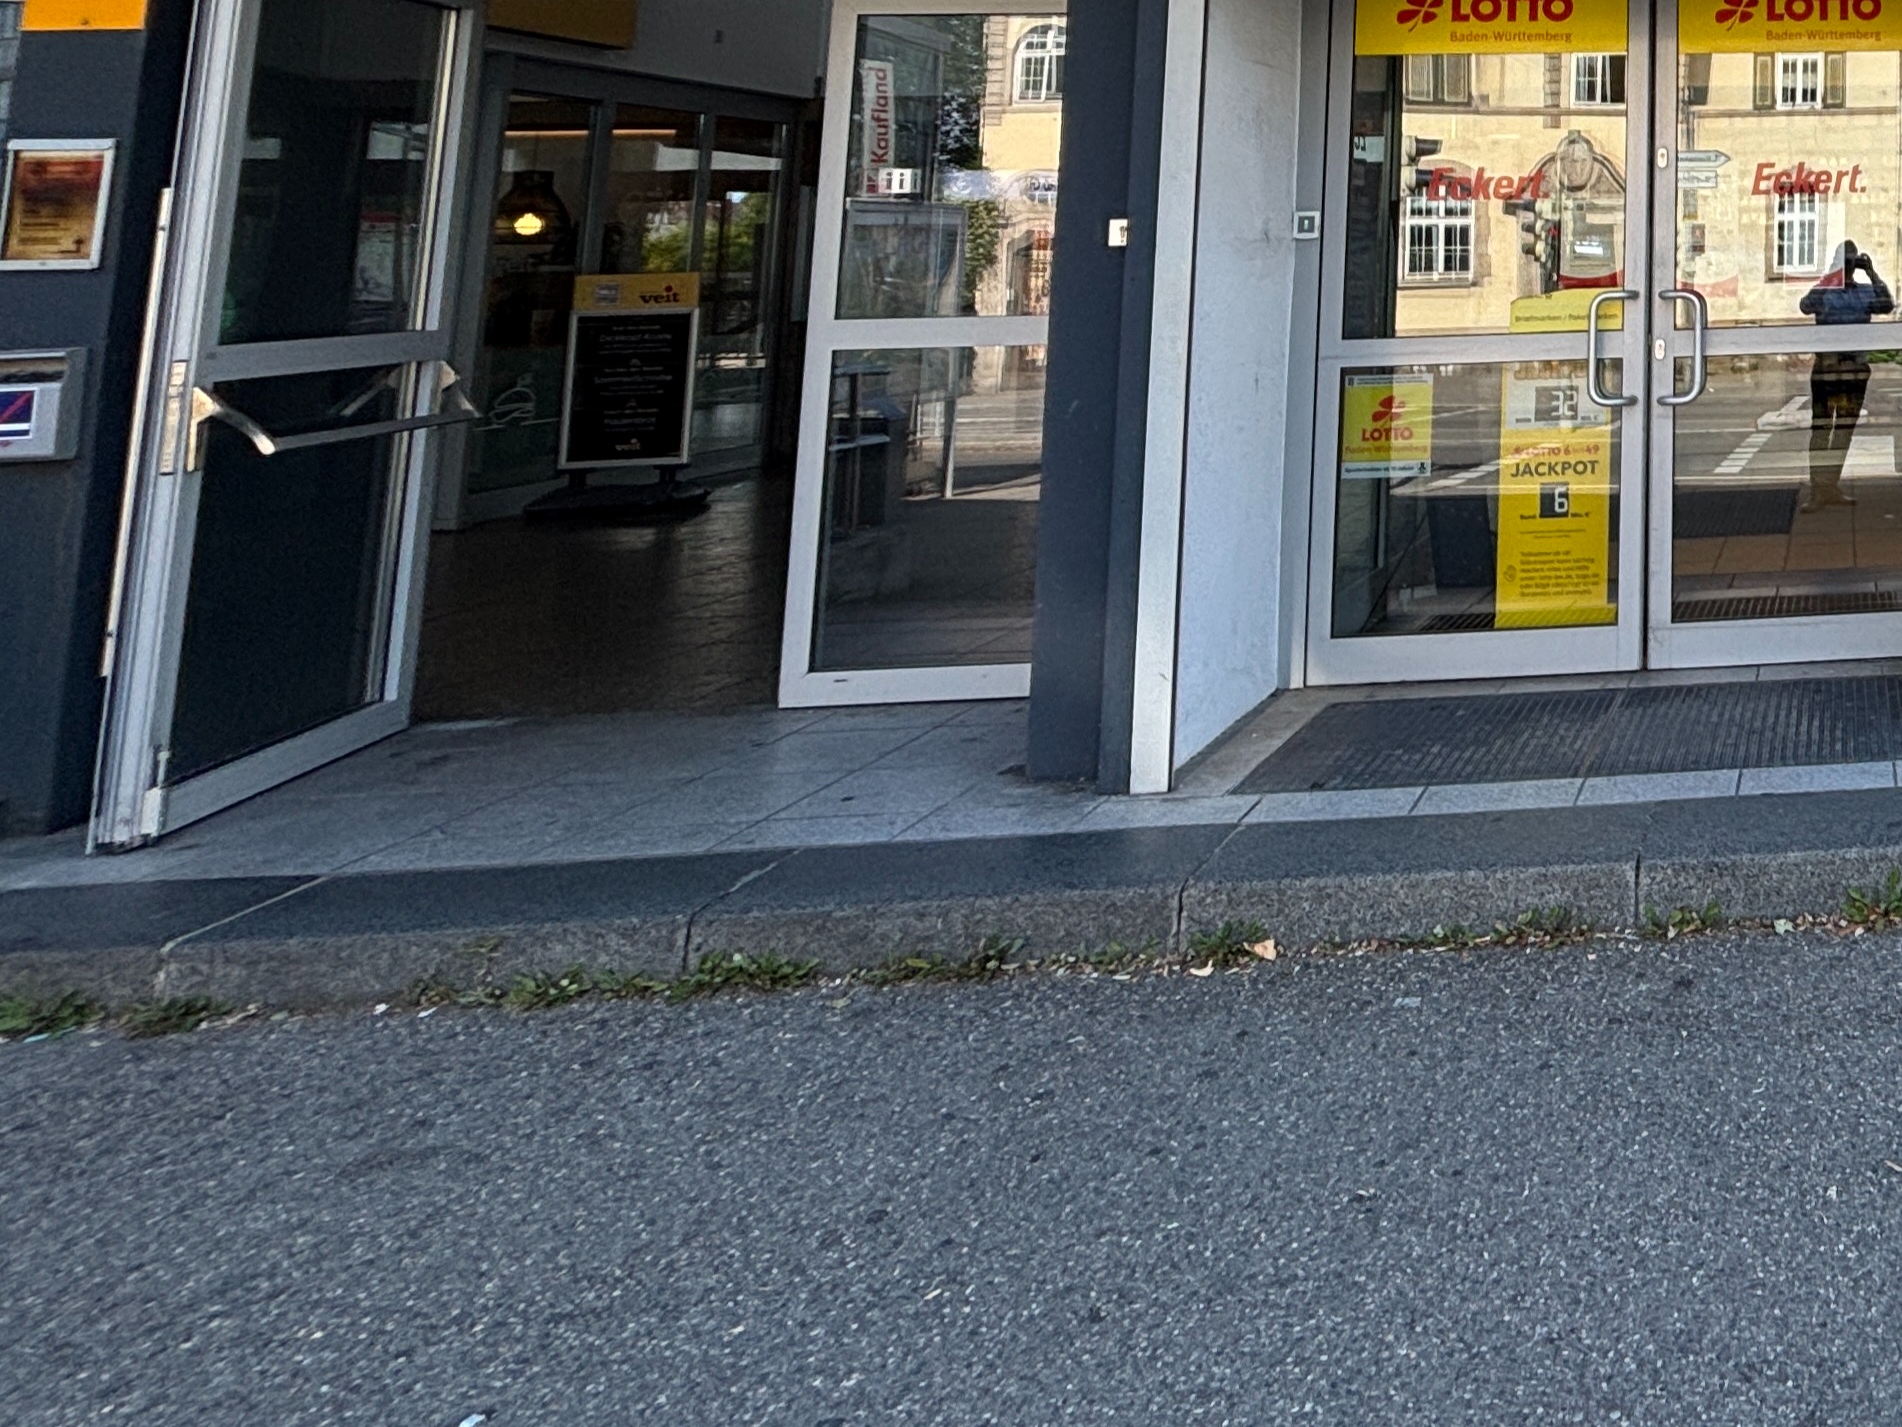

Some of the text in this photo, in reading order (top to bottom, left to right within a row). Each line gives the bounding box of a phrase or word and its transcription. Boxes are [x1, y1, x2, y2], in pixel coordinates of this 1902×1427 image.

[1450, 30, 1572, 43] Baden-Württemberg
[1766, 29, 1882, 42] Baden-Württemberg
[867, 66, 889, 164] Kaufland
[1426, 167, 1549, 201] Eckert.
[1751, 162, 1867, 195] Eckert.
[639, 285, 680, 304] veit
[1551, 390, 1577, 416] 32
[1362, 426, 1414, 442] LOTTO
[1510, 459, 1600, 478] JACKPOT
[1554, 485, 1569, 513] 6
